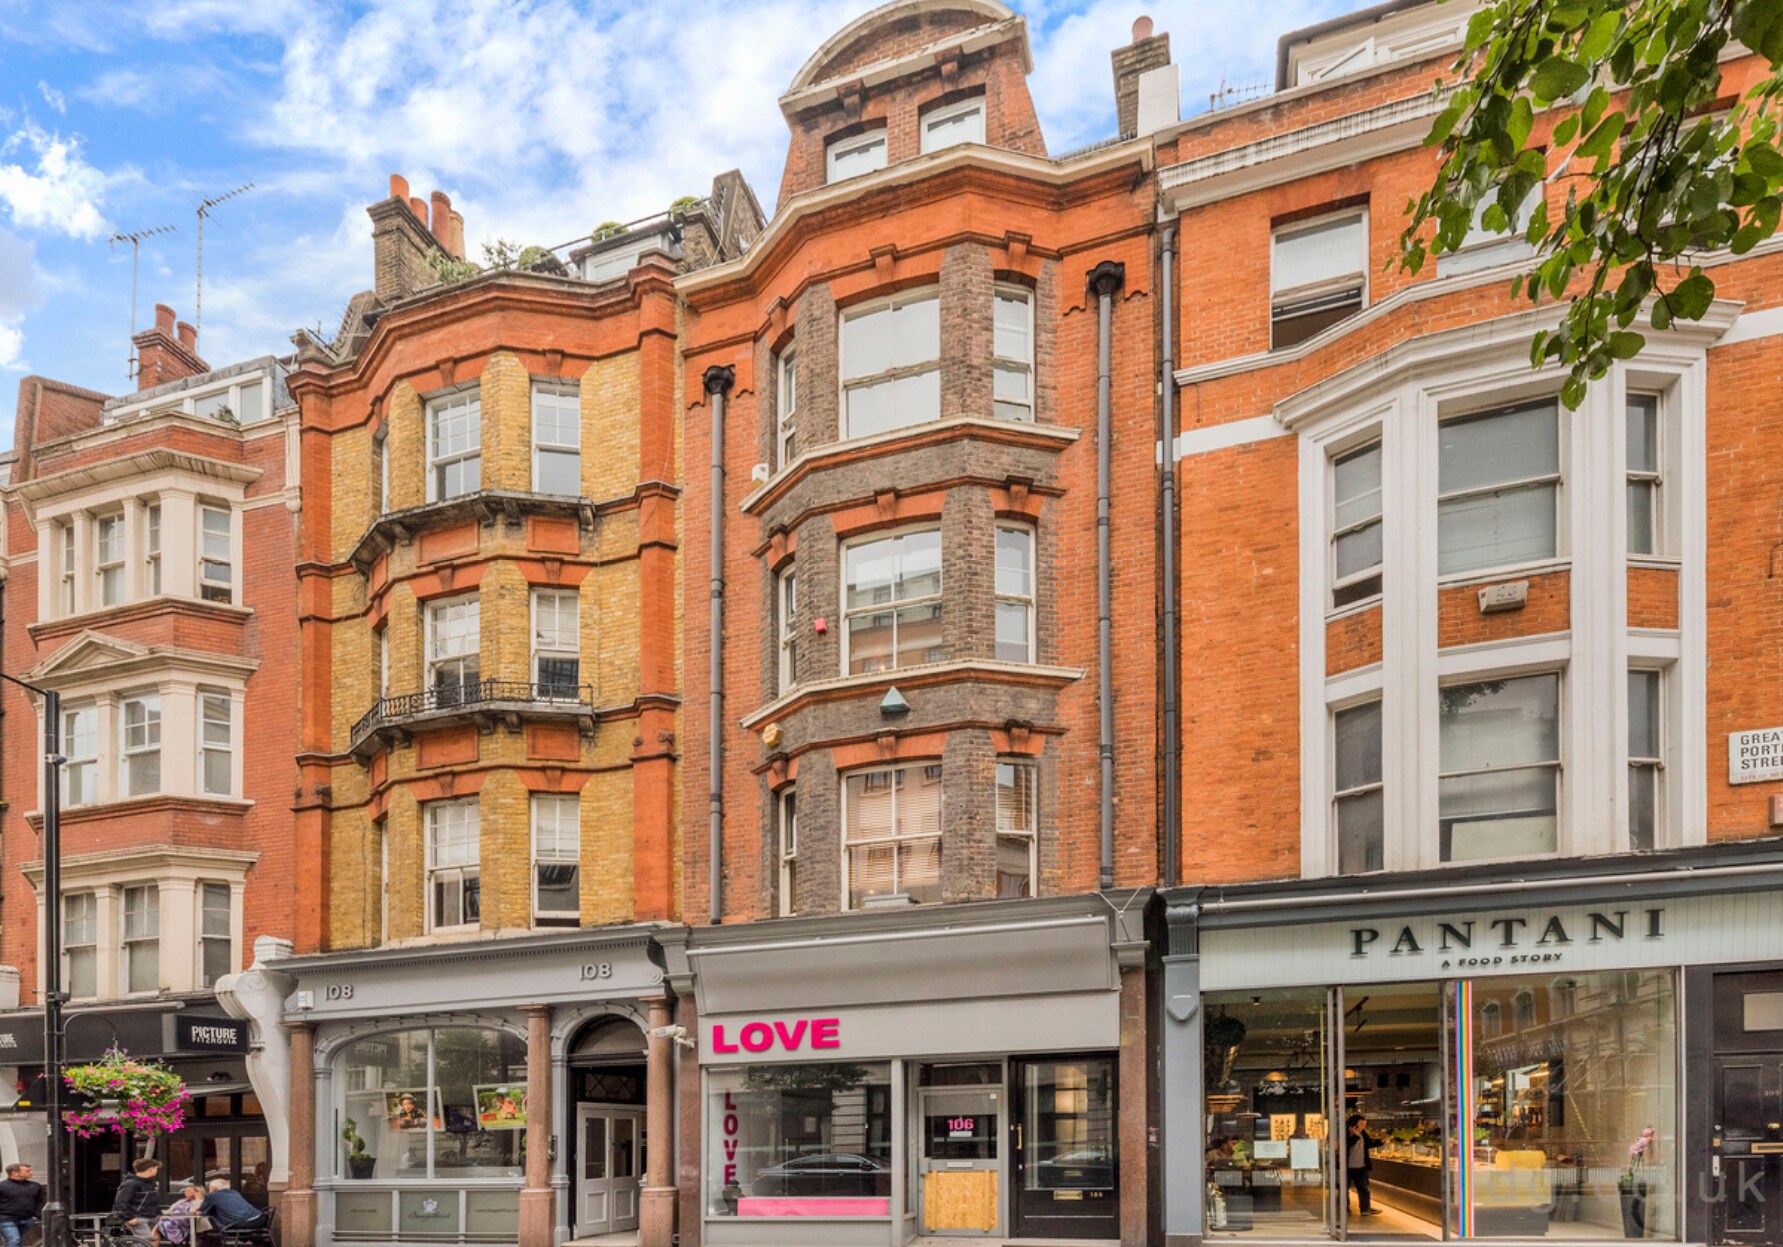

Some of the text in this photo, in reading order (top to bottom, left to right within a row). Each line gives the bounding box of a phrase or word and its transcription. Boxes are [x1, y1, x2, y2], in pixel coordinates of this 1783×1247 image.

[1350, 908, 1666, 957] PANTANI
[1441, 952, 1563, 968] A FOOD STORY
[579, 962, 612, 981] 108
[325, 984, 353, 1000] 108
[191, 1026, 237, 1040] PICTURE
[712, 1018, 840, 1054] LOVE
[946, 1118, 975, 1131] 106
[723, 1087, 739, 1186] LOVE
